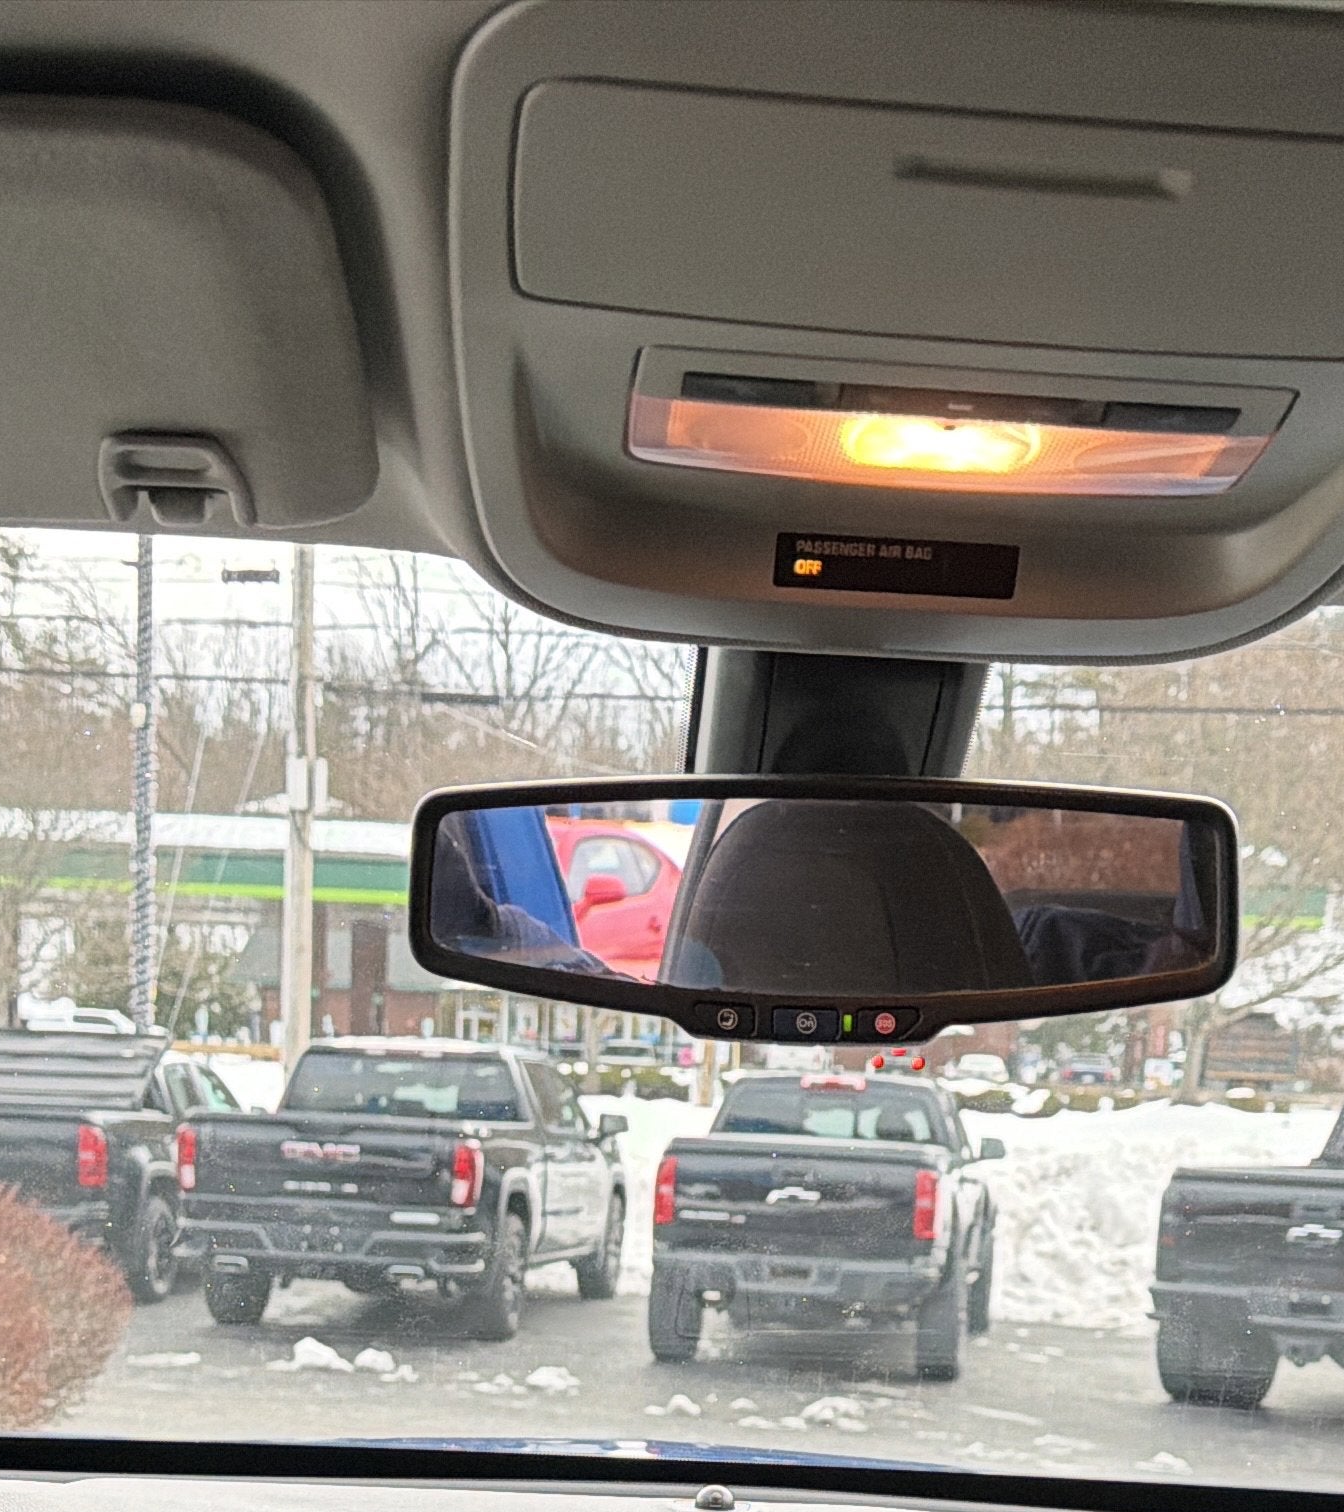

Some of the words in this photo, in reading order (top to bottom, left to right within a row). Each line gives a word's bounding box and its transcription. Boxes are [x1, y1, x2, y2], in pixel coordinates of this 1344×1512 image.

[796, 540, 876, 557] PASSENGER
[878, 545, 902, 560] AIR
[905, 546, 933, 561] BAG
[793, 559, 823, 575] OFF
